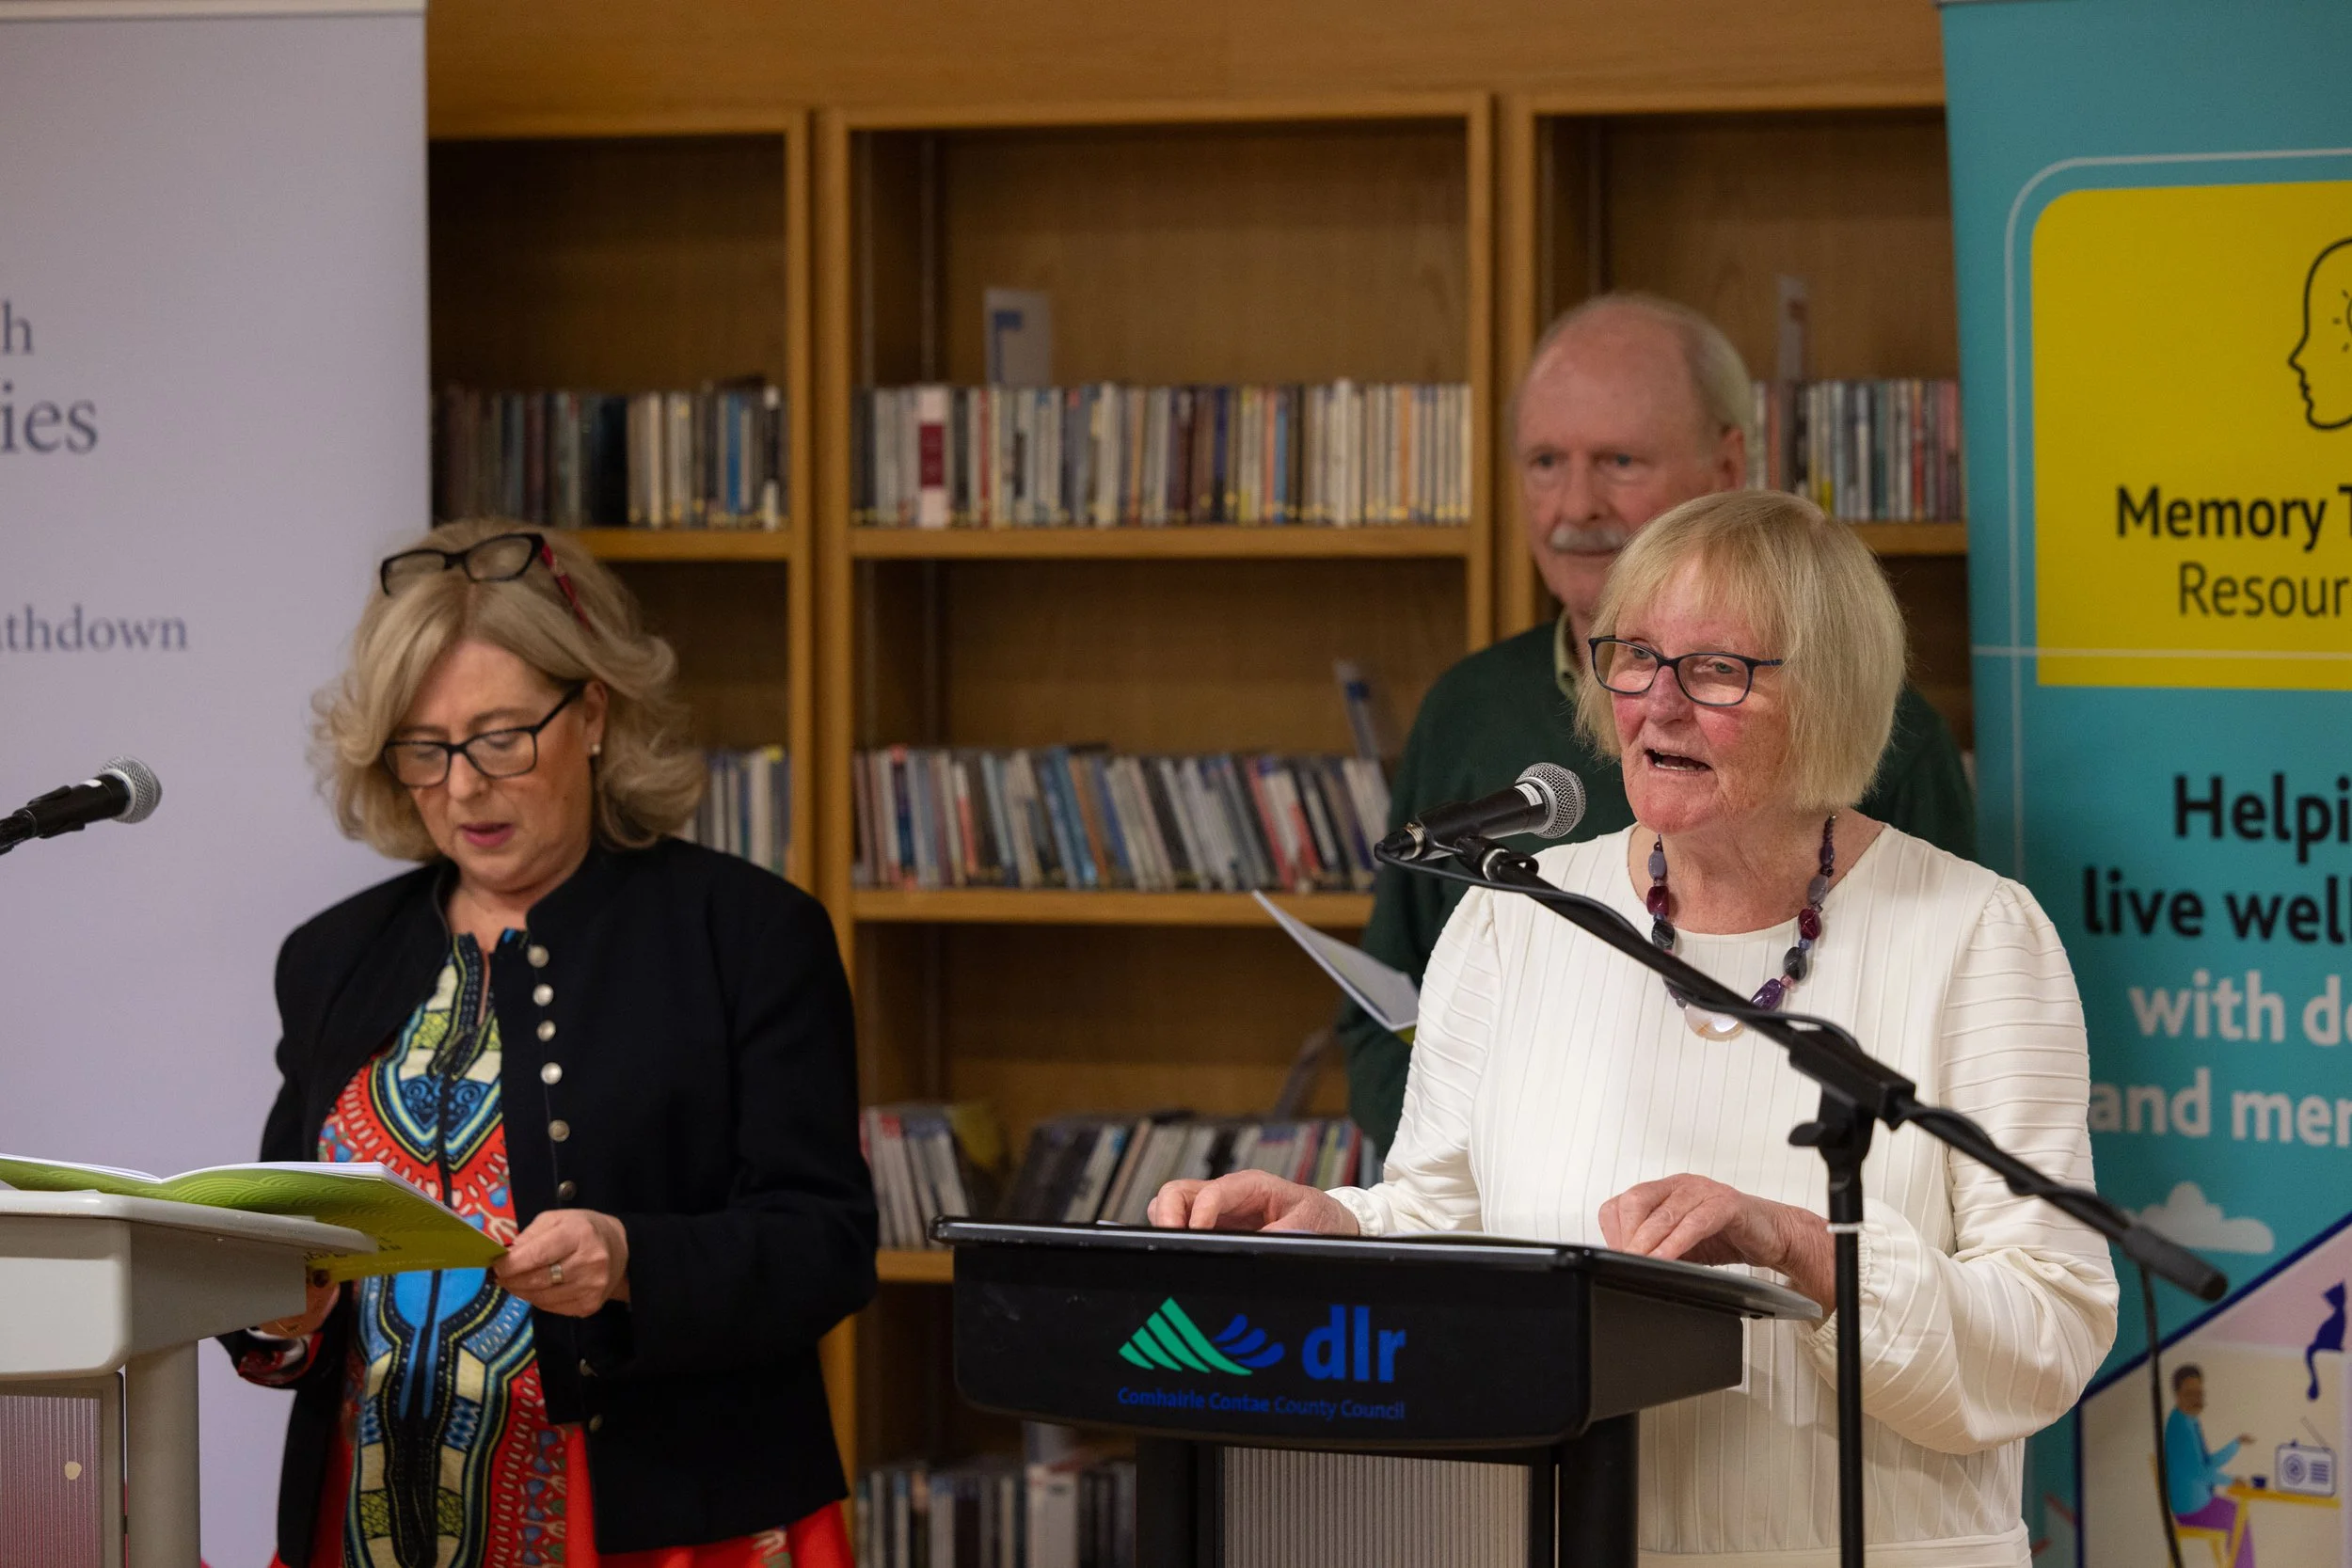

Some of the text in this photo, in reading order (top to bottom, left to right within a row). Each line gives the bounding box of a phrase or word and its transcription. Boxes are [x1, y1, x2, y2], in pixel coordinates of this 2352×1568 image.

[2117, 484, 2327, 553] Memory
[2179, 561, 2351, 618] Resour
[0, 604, 187, 652] thdown
[2174, 771, 2351, 865] Helpi
[2082, 865, 2352, 945] live wel
[2129, 970, 2352, 1046] with d
[2088, 1066, 2212, 1138] and
[1302, 1304, 1406, 1383] dlr
[1117, 1386, 1406, 1421] Comhairle Contae County Council
